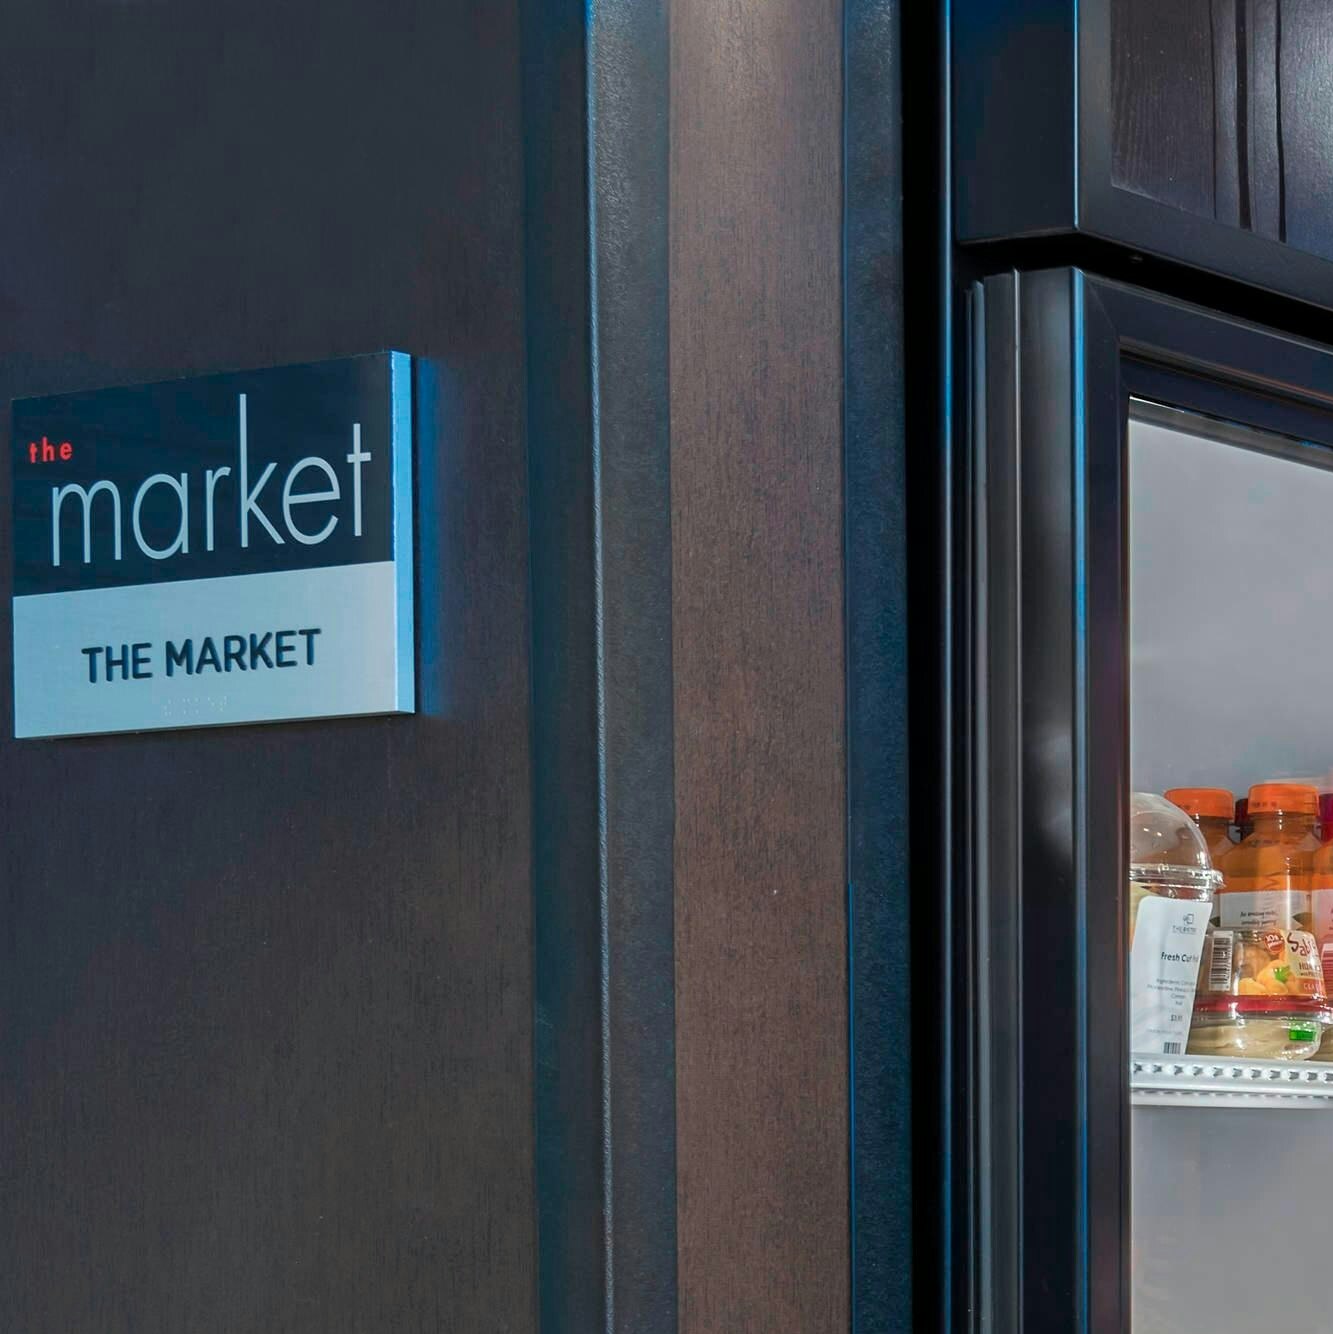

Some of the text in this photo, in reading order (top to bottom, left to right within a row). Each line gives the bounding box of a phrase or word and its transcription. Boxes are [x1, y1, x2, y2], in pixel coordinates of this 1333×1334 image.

[29, 437, 73, 464] the
[52, 393, 372, 567] market
[81, 628, 322, 684] THE MARKET
